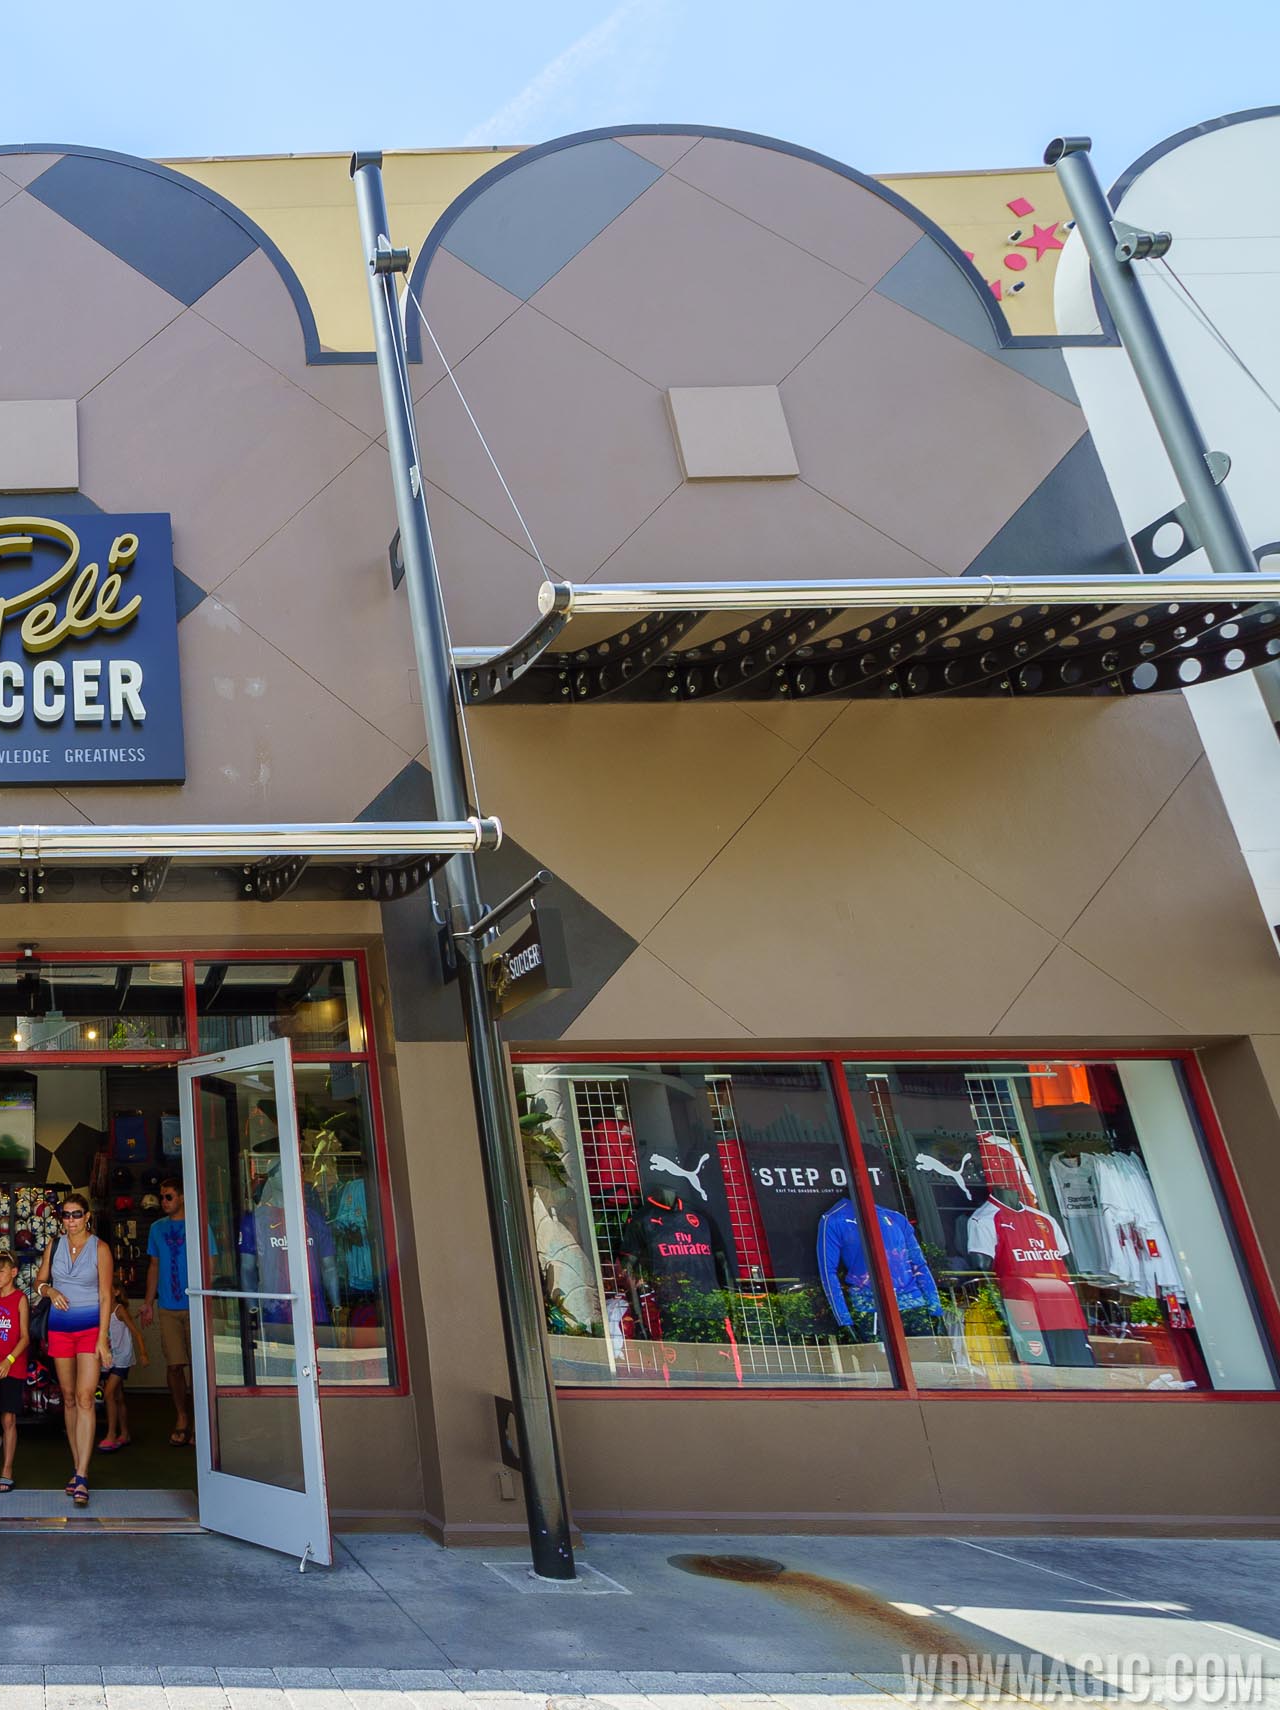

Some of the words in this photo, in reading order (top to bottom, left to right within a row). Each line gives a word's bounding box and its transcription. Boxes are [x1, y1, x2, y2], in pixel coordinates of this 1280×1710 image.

[64, 748, 146, 763] GREATNESS
[509, 944, 541, 979] SOCCER
[759, 1167, 819, 1186] STEP
[830, 1167, 880, 1186] OT
[675, 1232, 692, 1243] Fly
[1028, 1238, 1045, 1248] Fly
[658, 1242, 711, 1256] Emirates
